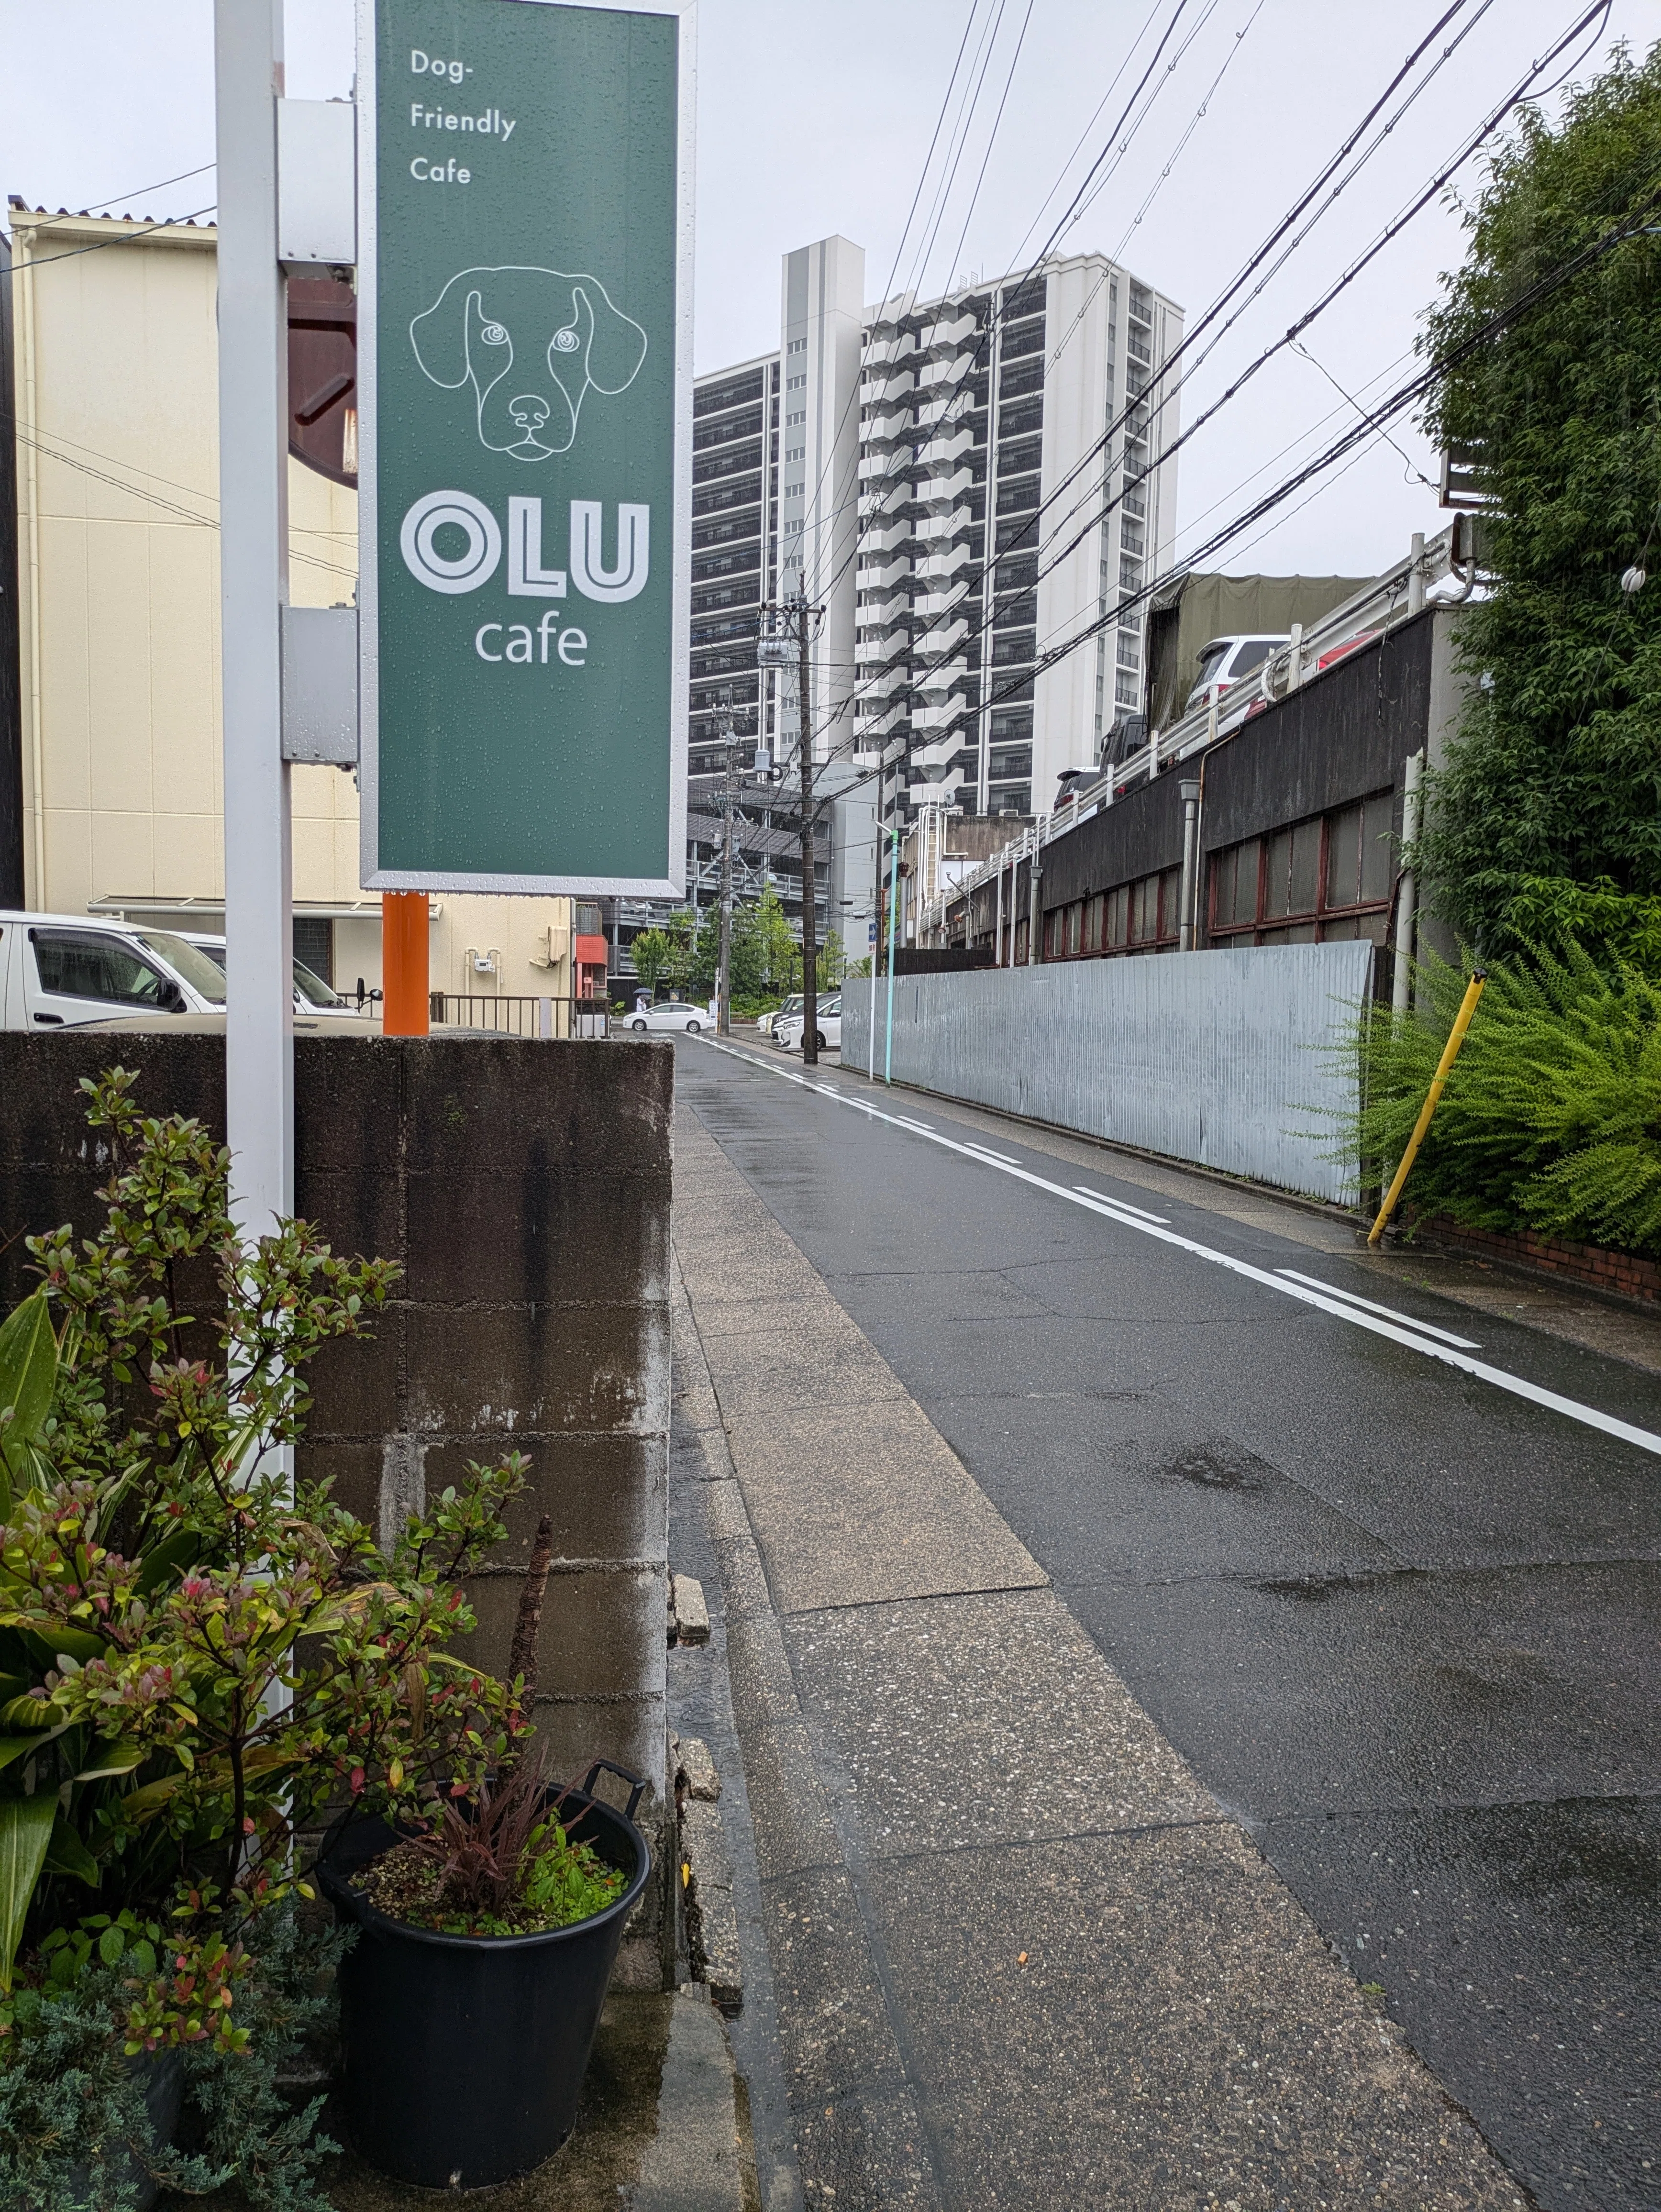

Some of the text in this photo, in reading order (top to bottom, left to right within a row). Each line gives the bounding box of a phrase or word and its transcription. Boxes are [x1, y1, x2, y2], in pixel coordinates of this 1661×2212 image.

[411, 49, 473, 84] Dog-
[411, 103, 516, 142] Friendly
[410, 157, 471, 184] Cafe
[400, 490, 650, 603] OLU
[476, 610, 587, 666] cafe
